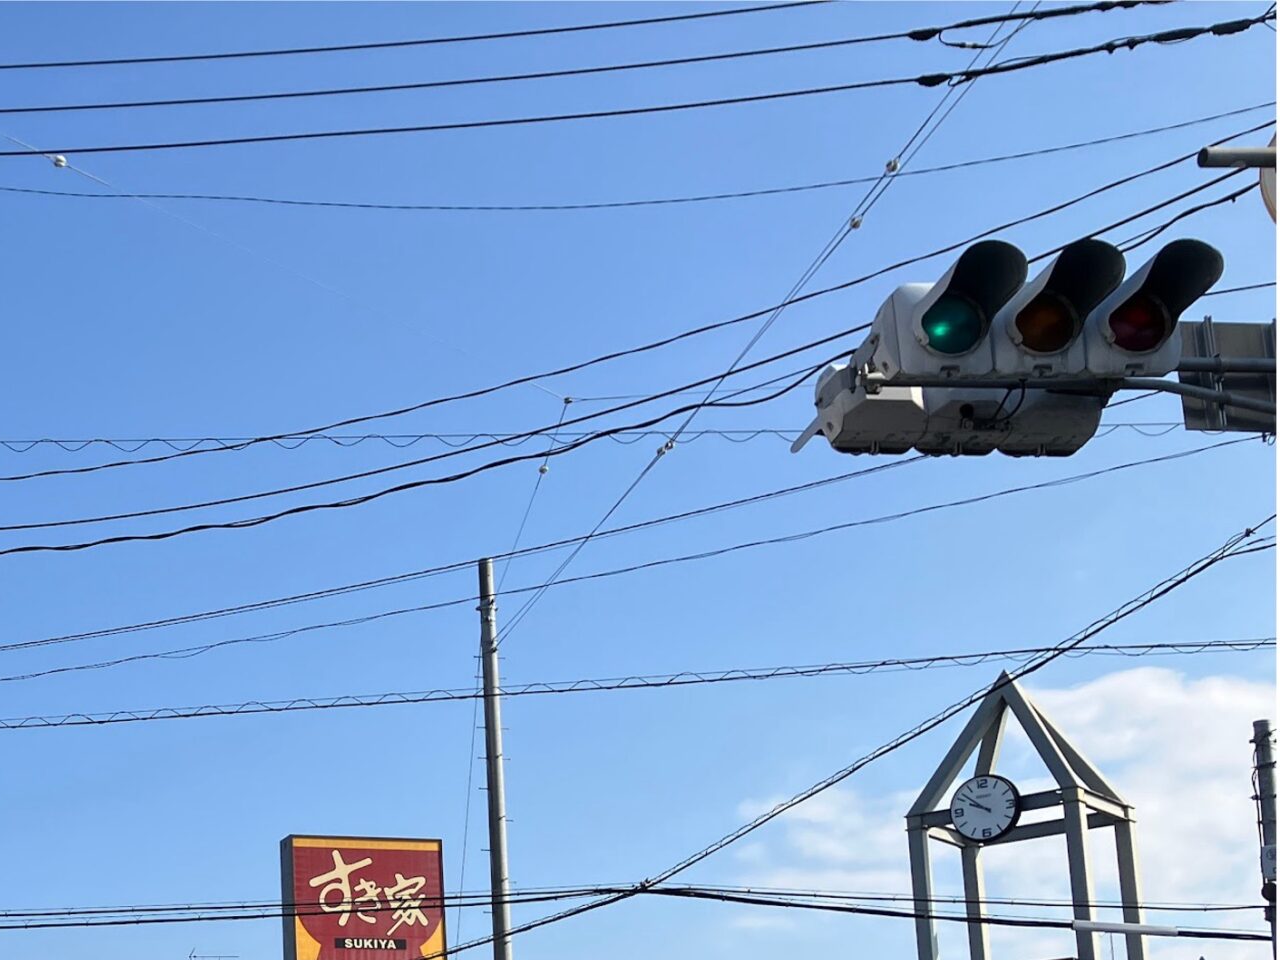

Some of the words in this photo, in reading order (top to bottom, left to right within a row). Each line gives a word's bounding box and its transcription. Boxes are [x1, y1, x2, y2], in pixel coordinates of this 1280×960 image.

[976, 779, 988, 789] 12
[1005, 799, 1015, 810] 3
[954, 808, 965, 818] 9
[982, 827, 992, 838] 6
[309, 849, 429, 936] すき家
[344, 938, 397, 950] SUKIYA
